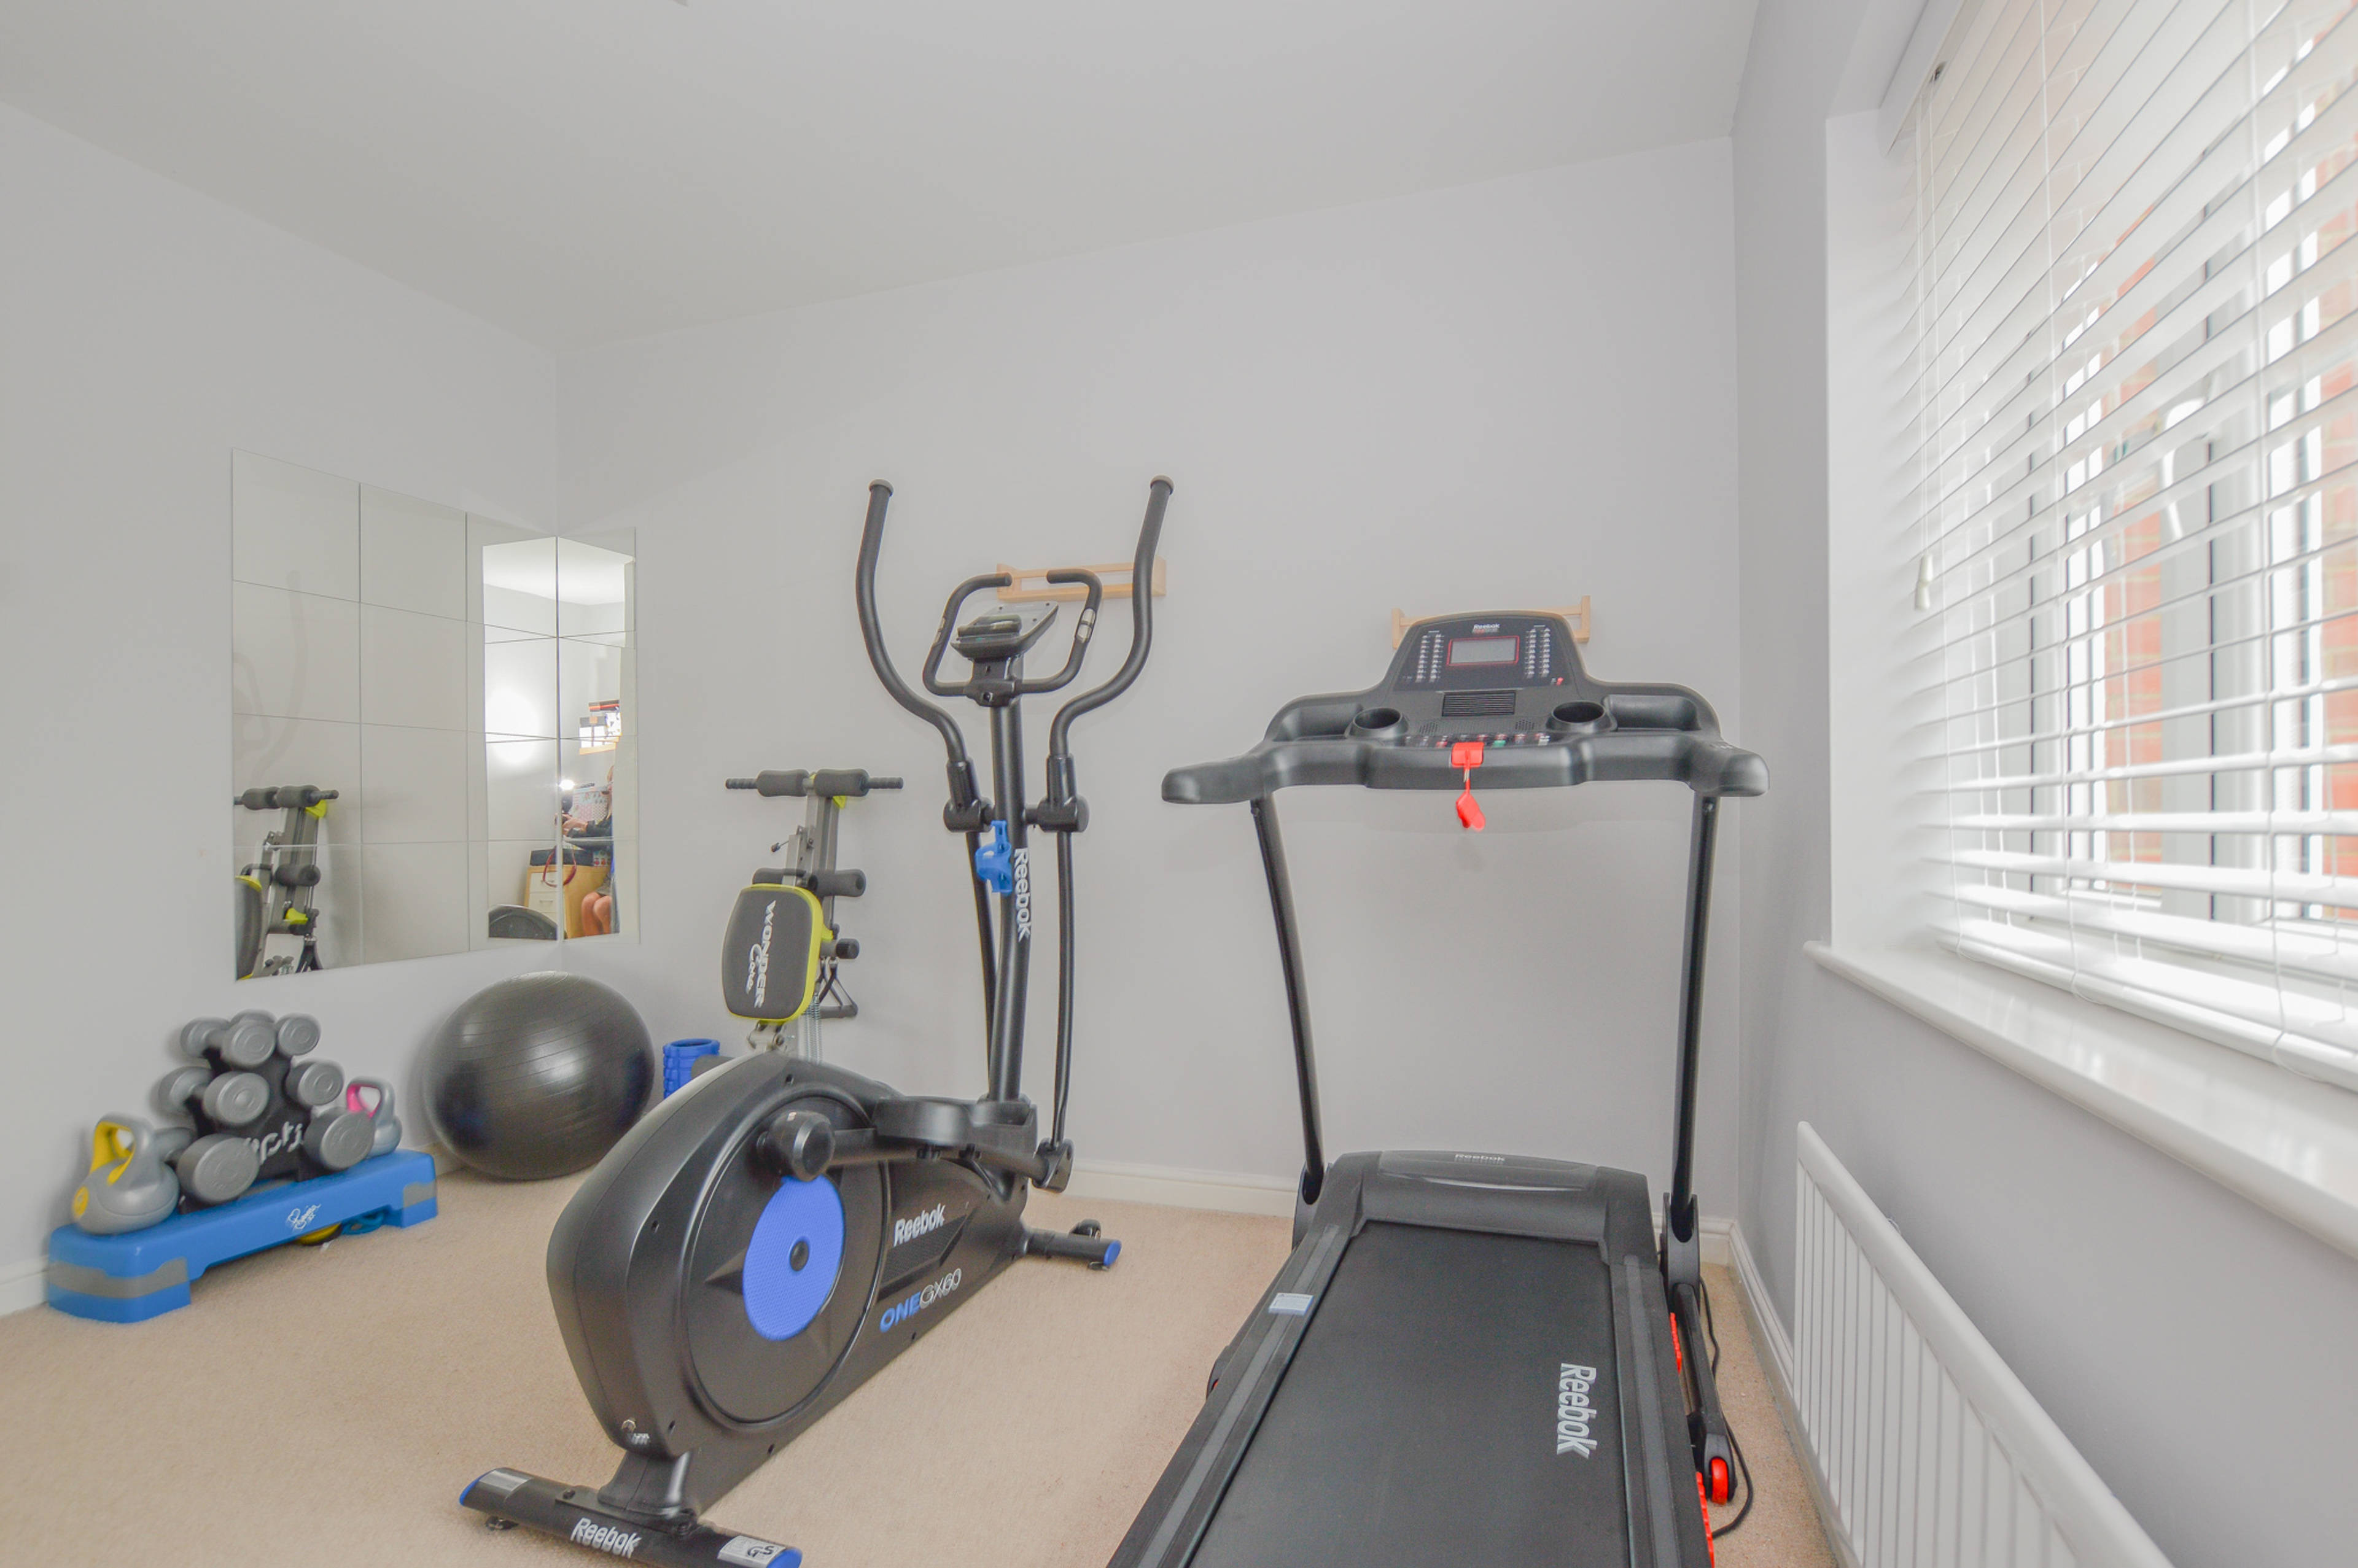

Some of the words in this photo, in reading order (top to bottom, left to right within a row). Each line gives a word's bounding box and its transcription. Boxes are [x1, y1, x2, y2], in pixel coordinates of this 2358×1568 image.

[1014, 847, 1032, 942] Reebok
[745, 943, 762, 995] Core
[753, 899, 777, 1008] WONDER
[1454, 1154, 1505, 1163] Reebok
[893, 1203, 946, 1248] Reebok
[1557, 1362, 1598, 1459] Reebok
[570, 1517, 642, 1558] Reebok
